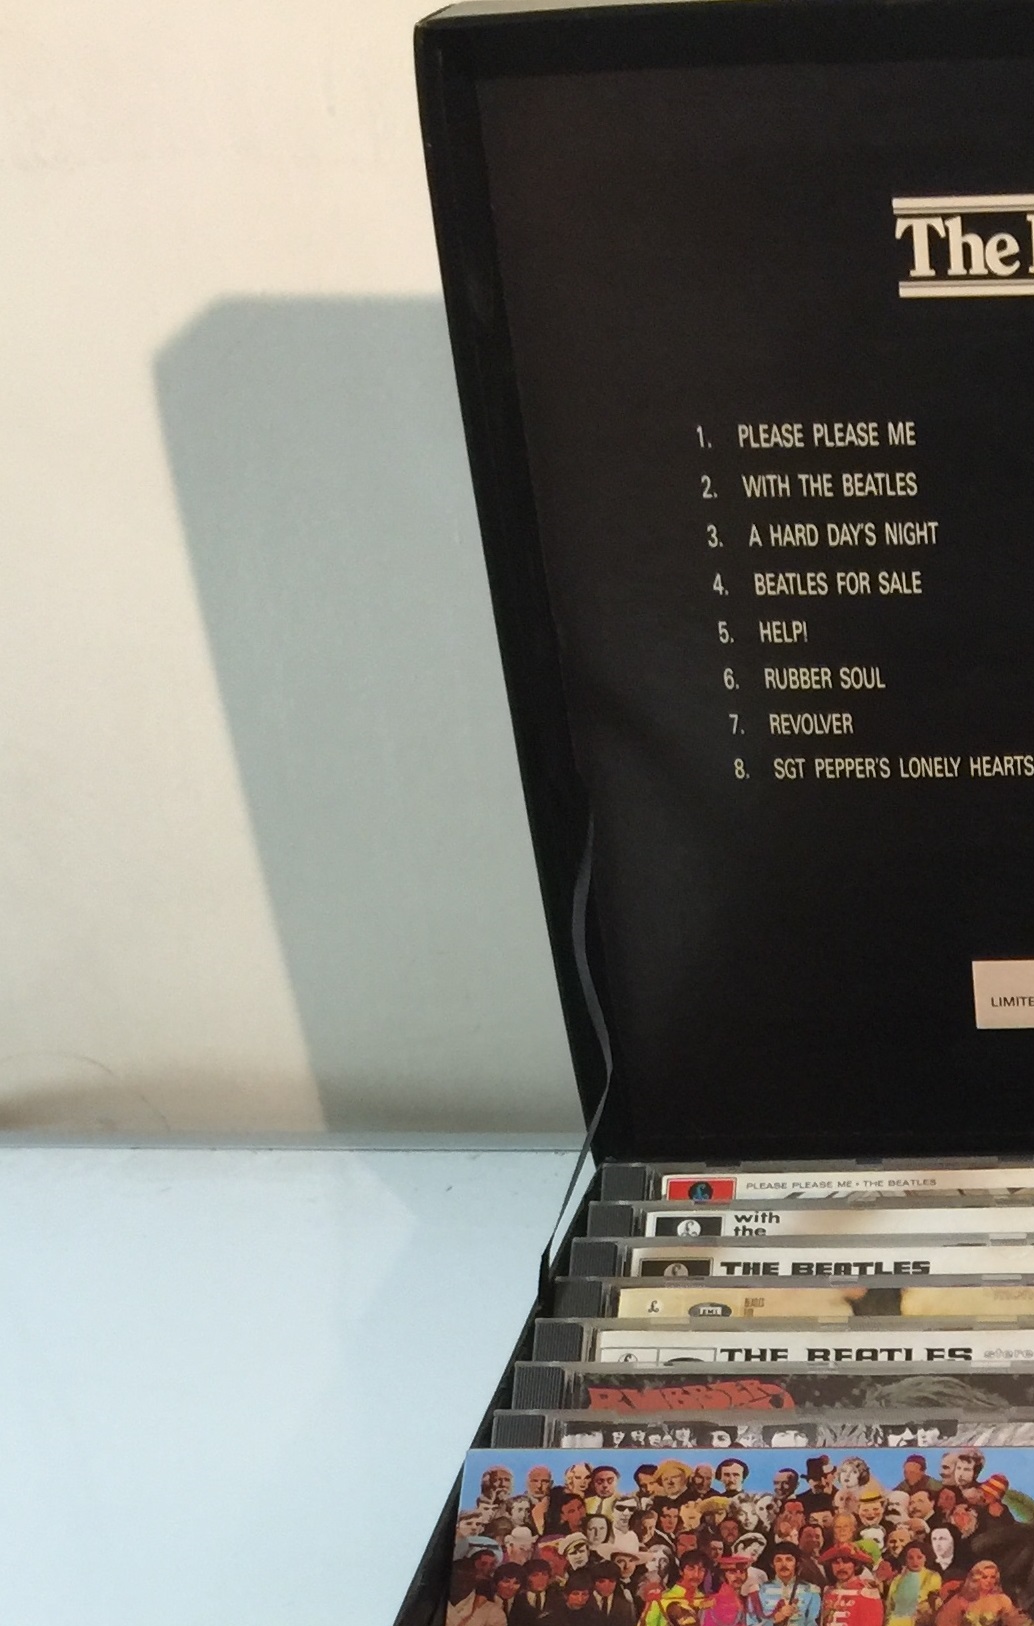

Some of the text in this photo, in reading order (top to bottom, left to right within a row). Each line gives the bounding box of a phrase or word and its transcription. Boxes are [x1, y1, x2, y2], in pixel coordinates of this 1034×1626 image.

[895, 216, 1021, 278] The
[696, 421, 917, 449] 1. PLEASE PLEASE ME
[700, 471, 918, 499] 2. WITH THE BEATLES
[706, 521, 939, 548] 3. A HARD DAY'S NIGHT
[712, 570, 923, 596] 4. BEATLES FOR SALE
[717, 620, 808, 644] 5. HELP!
[723, 666, 886, 690] 6. RUBBER SOUL
[728, 712, 854, 735] 7. REVOLVER
[733, 757, 750, 780] 8.
[773, 757, 806, 780] SGT
[814, 757, 891, 779] PEPPER'S
[899, 756, 961, 779] LONELY
[969, 754, 1034, 777] HEARTS
[746, 1178, 938, 1190] PLEASE PLEASE ME THE BEATLES
[734, 1211, 781, 1225] with
[734, 1226, 766, 1237] the
[720, 1260, 931, 1276] THE BEATLES
